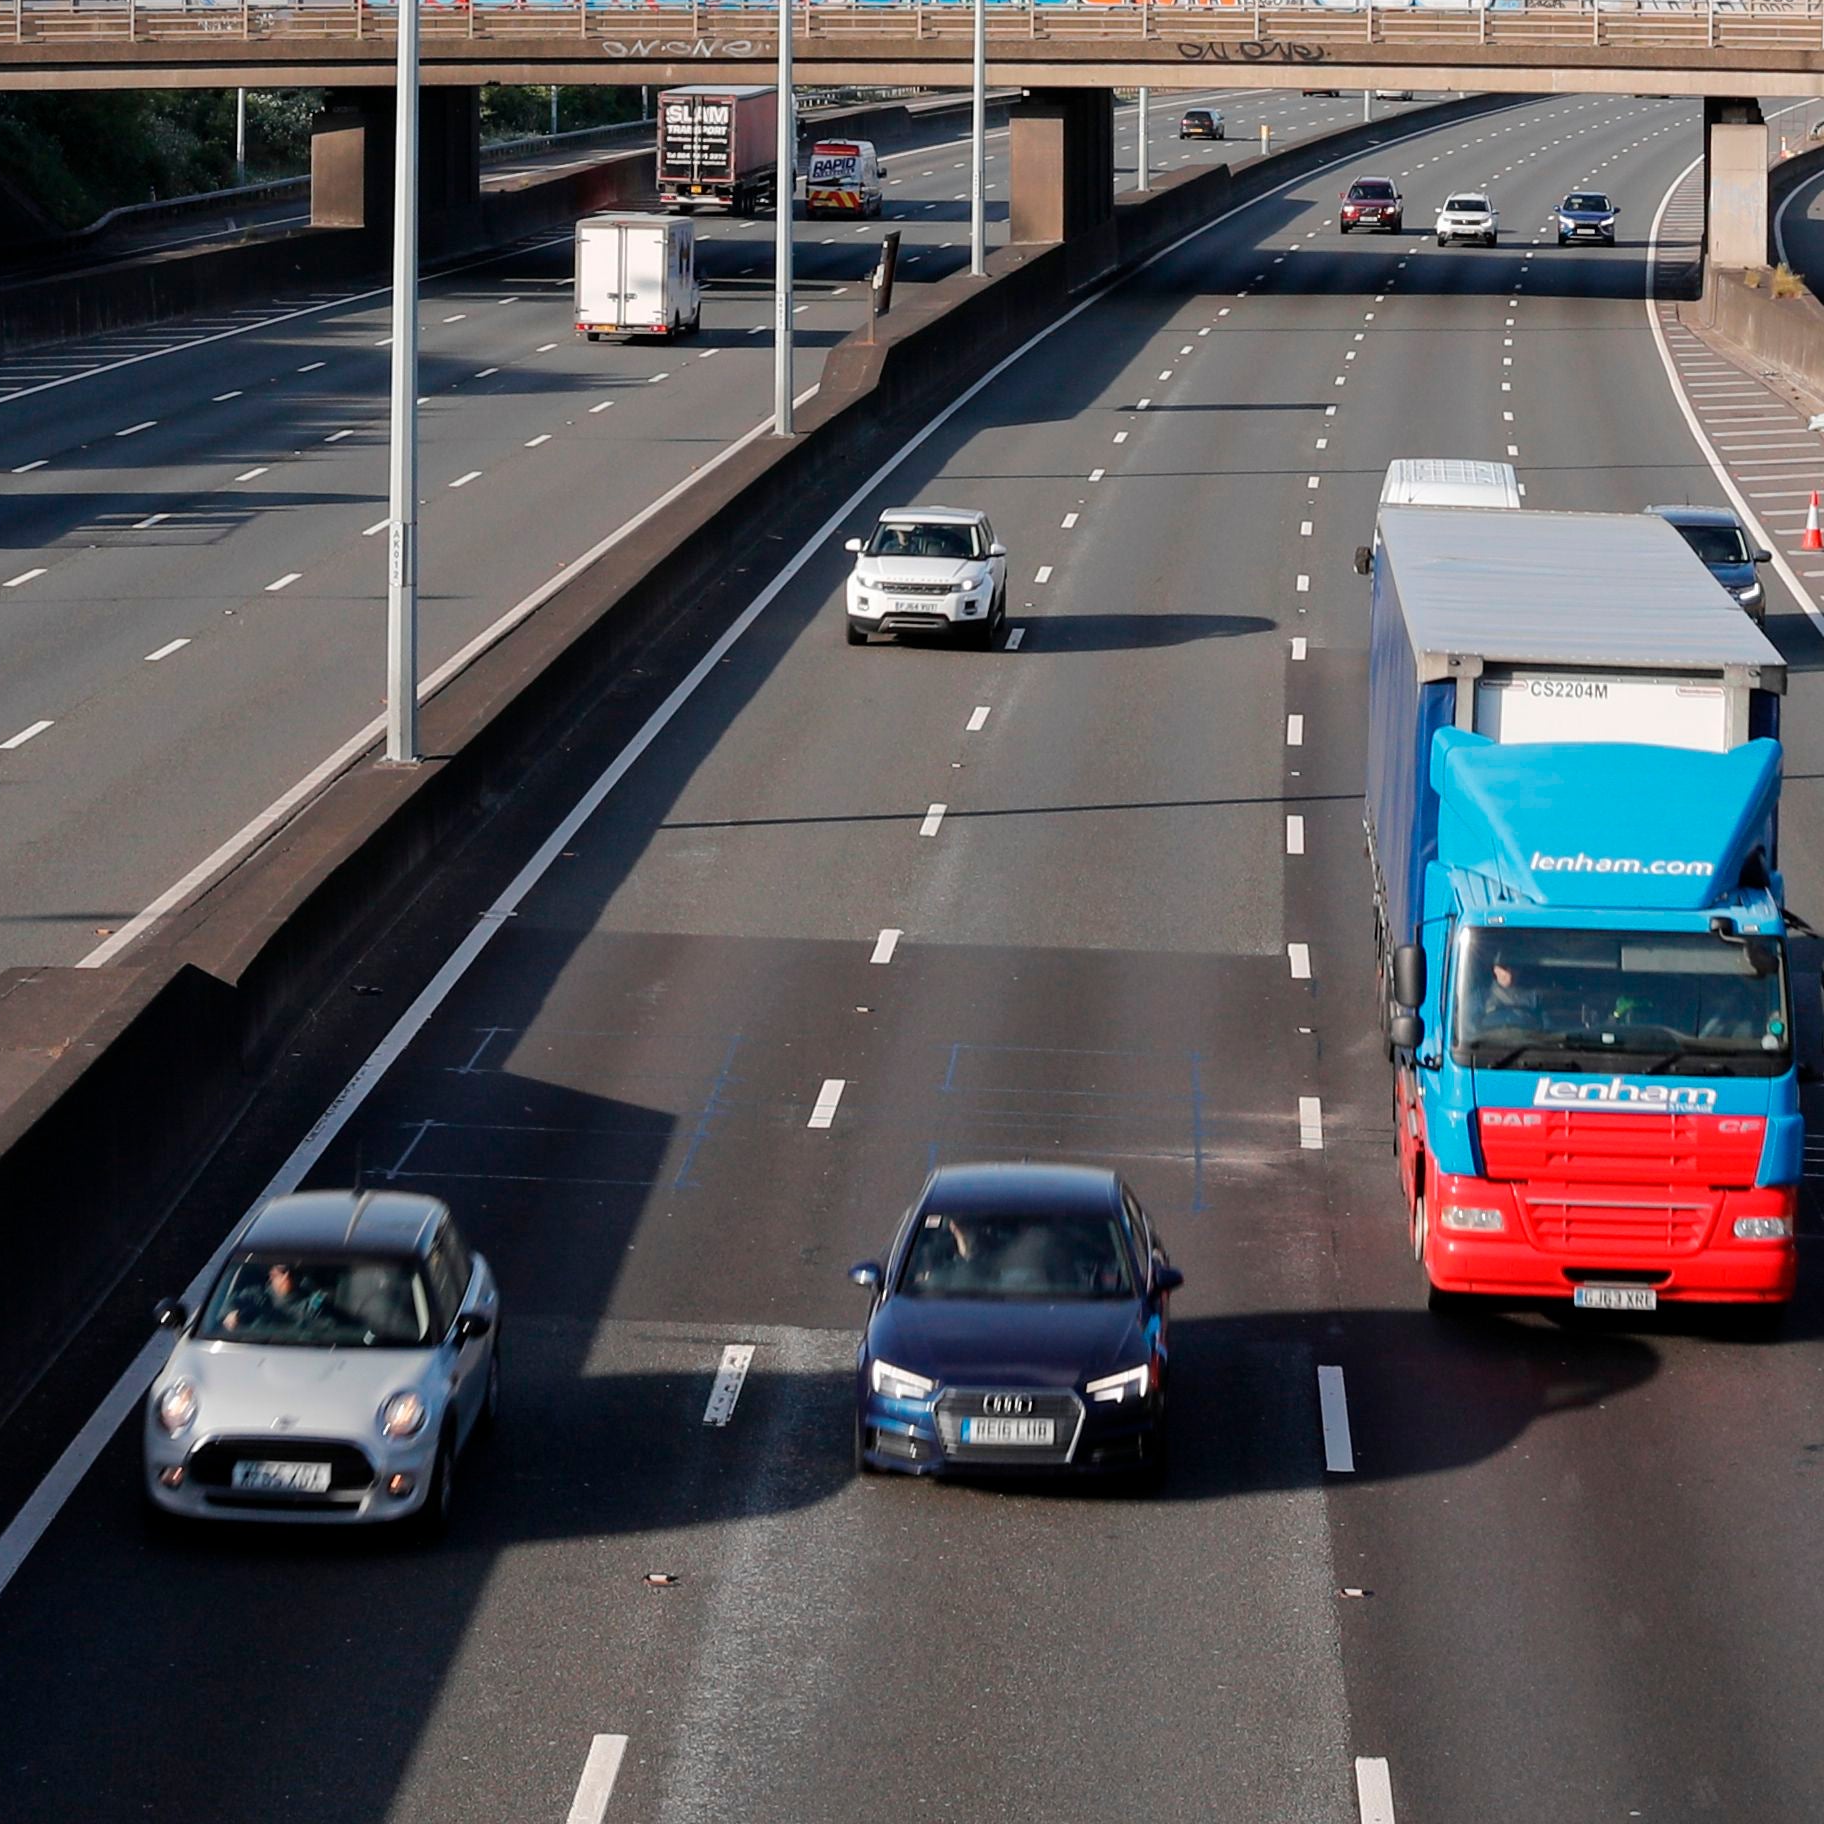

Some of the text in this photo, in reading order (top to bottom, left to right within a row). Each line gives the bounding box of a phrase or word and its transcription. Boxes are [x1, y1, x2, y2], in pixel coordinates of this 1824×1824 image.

[666, 105, 729, 125] SLAM
[813, 157, 856, 174] RAPID
[1530, 681, 1608, 699] CS2204M
[1530, 851, 1714, 876] lenham.com
[1533, 1077, 1717, 1111] Lenham
[1482, 1112, 1542, 1126] DAF
[1718, 1119, 1761, 1133] CF
